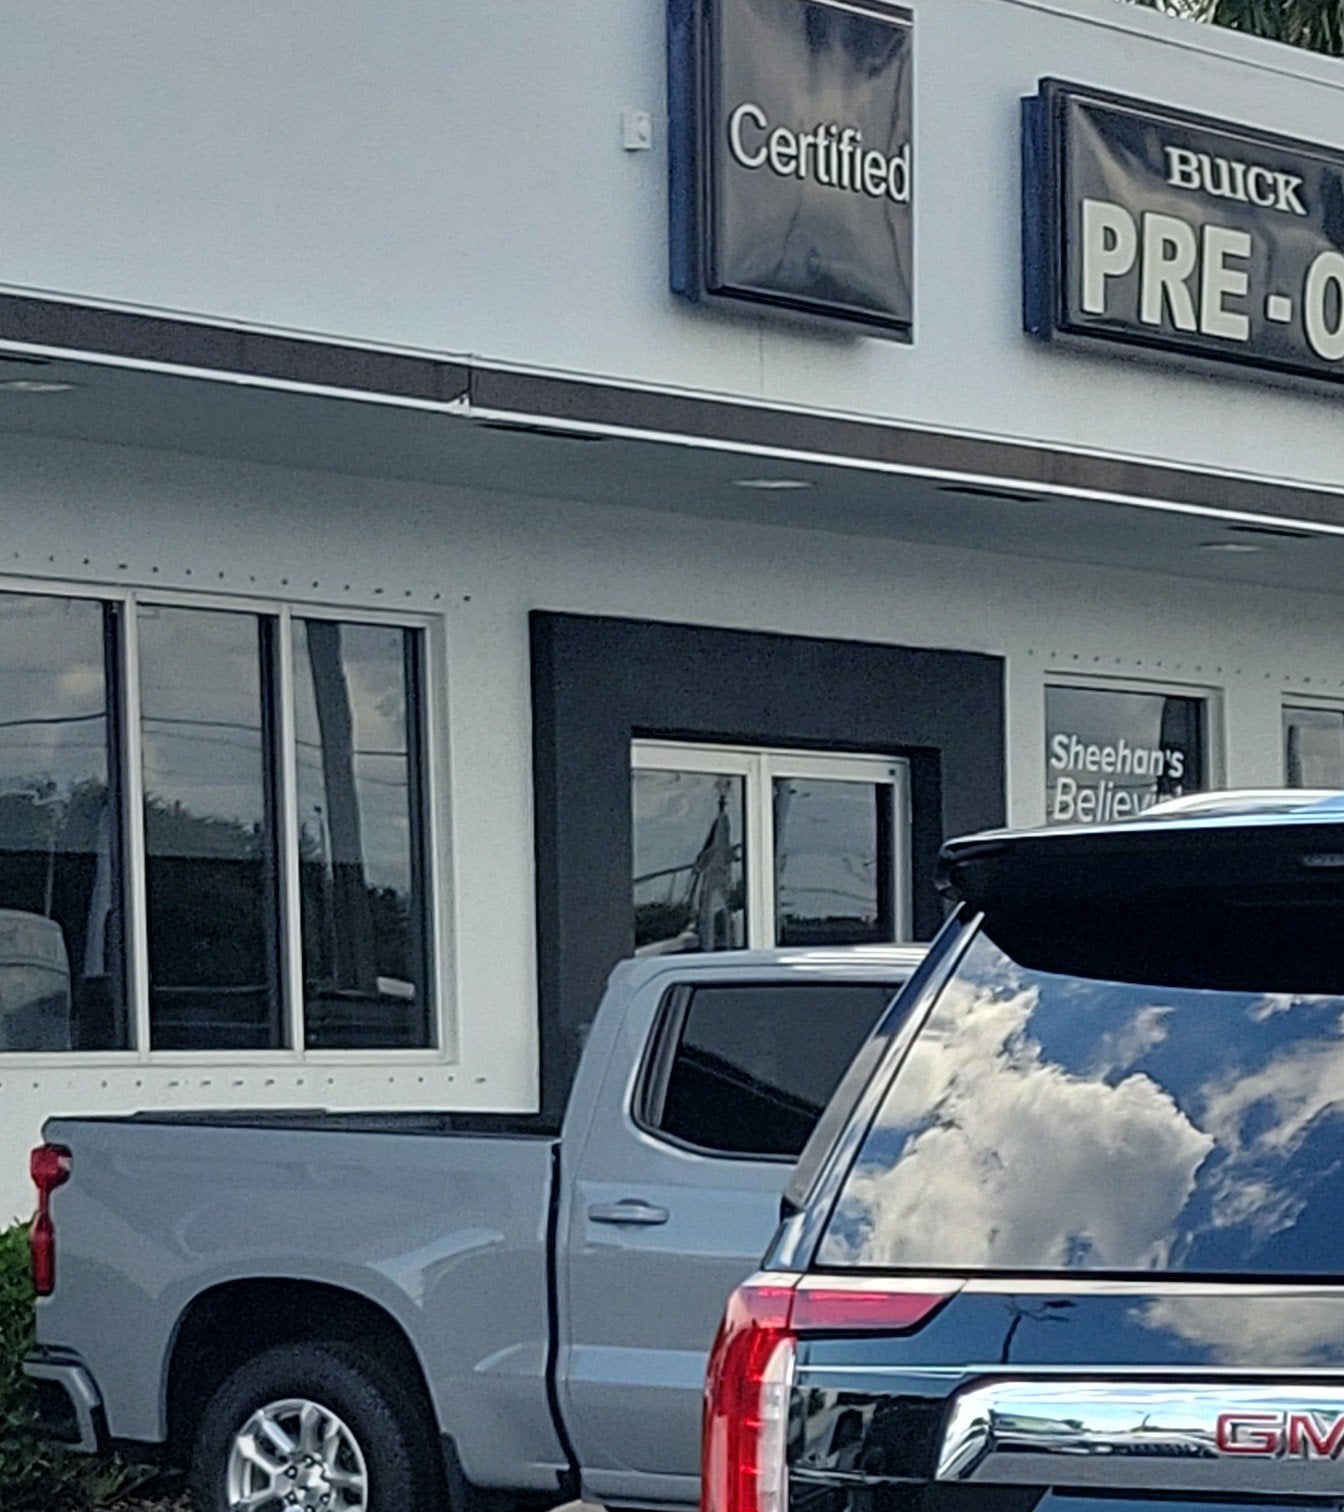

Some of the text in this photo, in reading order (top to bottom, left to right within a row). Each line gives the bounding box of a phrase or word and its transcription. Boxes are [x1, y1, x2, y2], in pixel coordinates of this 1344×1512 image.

[729, 102, 911, 203] Certified
[1163, 145, 1307, 216] BUICK
[1049, 734, 1185, 779] Sheehan's
